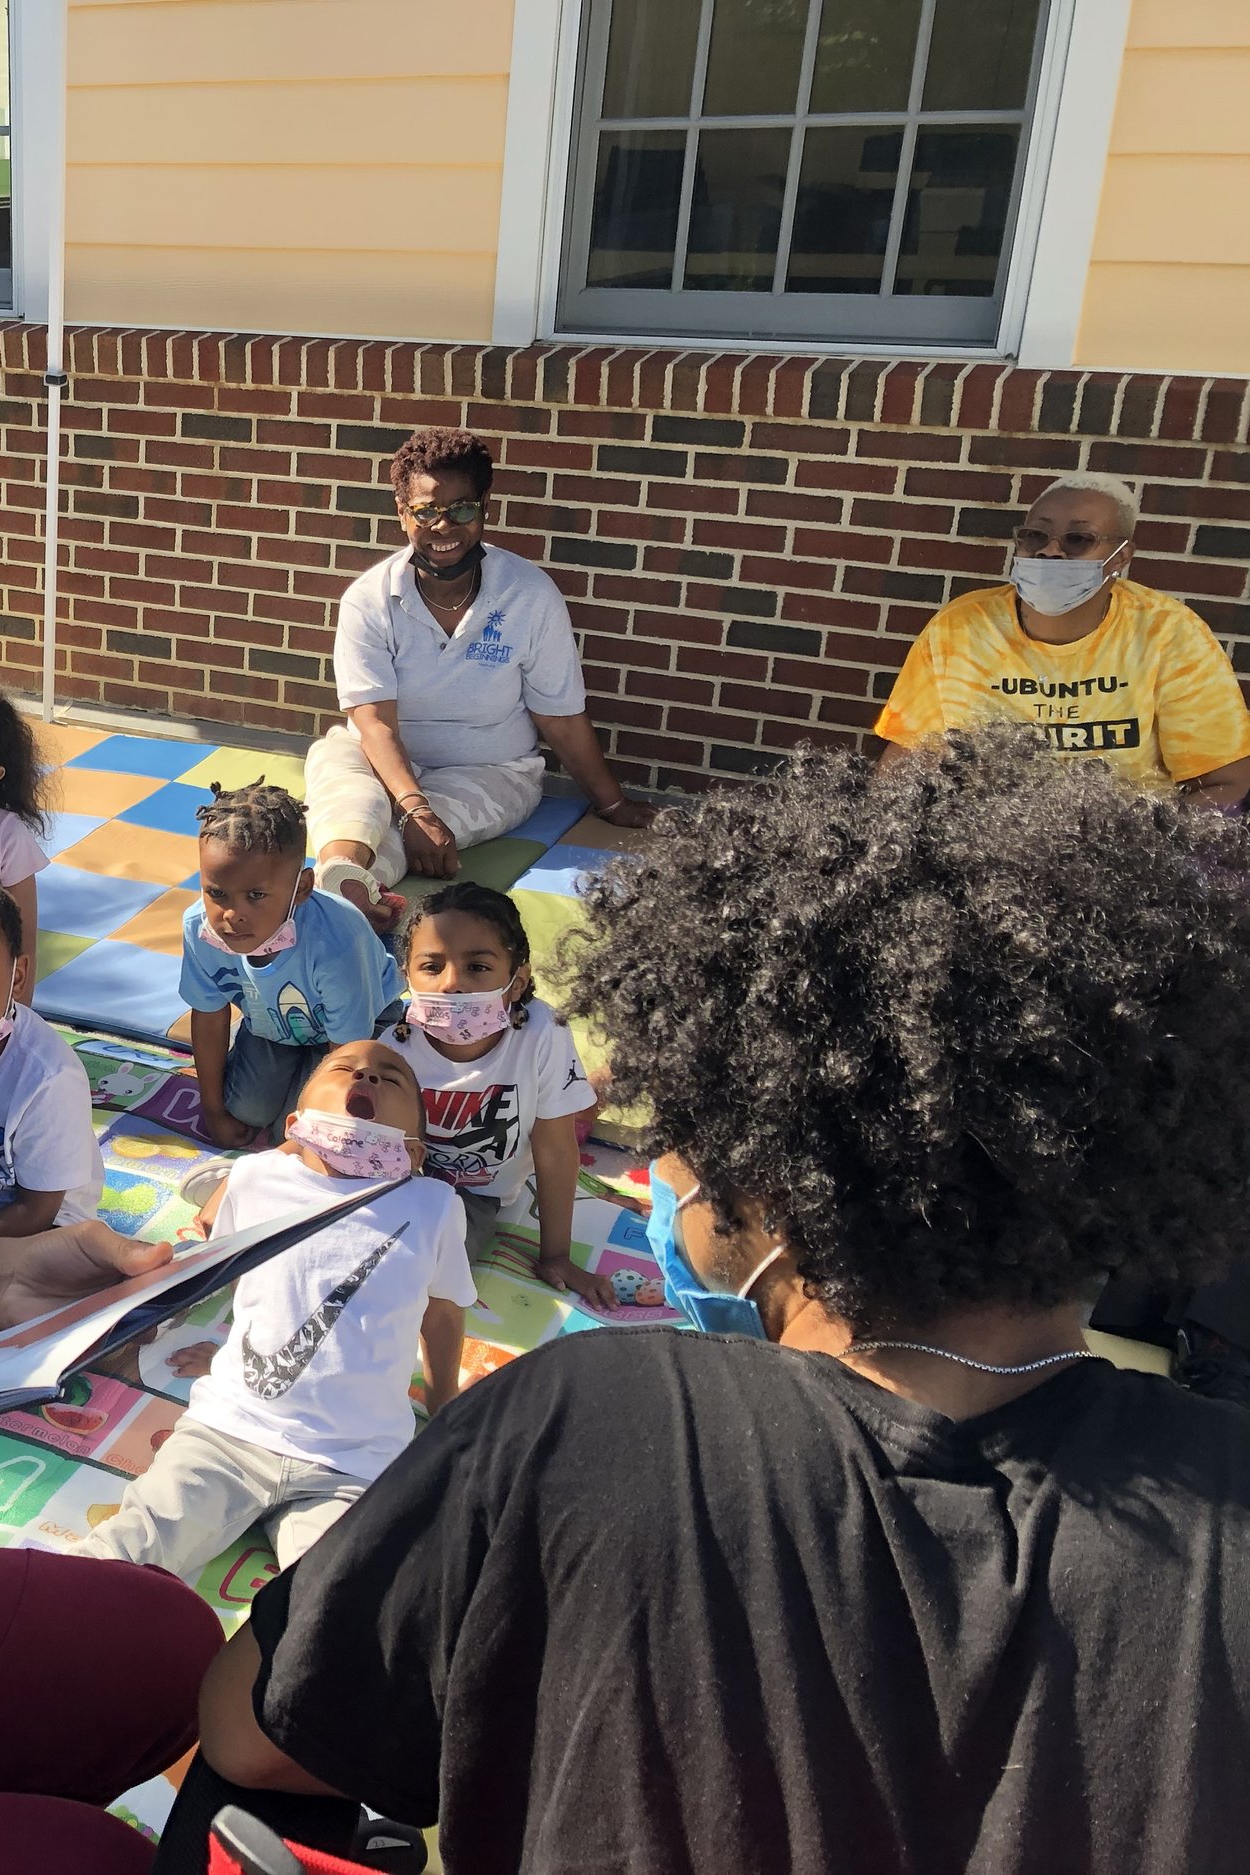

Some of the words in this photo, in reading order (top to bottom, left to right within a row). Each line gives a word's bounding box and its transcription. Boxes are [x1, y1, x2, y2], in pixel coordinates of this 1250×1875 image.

[467, 643, 513, 657] BRIGHT
[465, 653, 510, 664] BEGINNINGS
[1033, 703, 1080, 719] THE
[421, 1084, 516, 1131] NIKE
